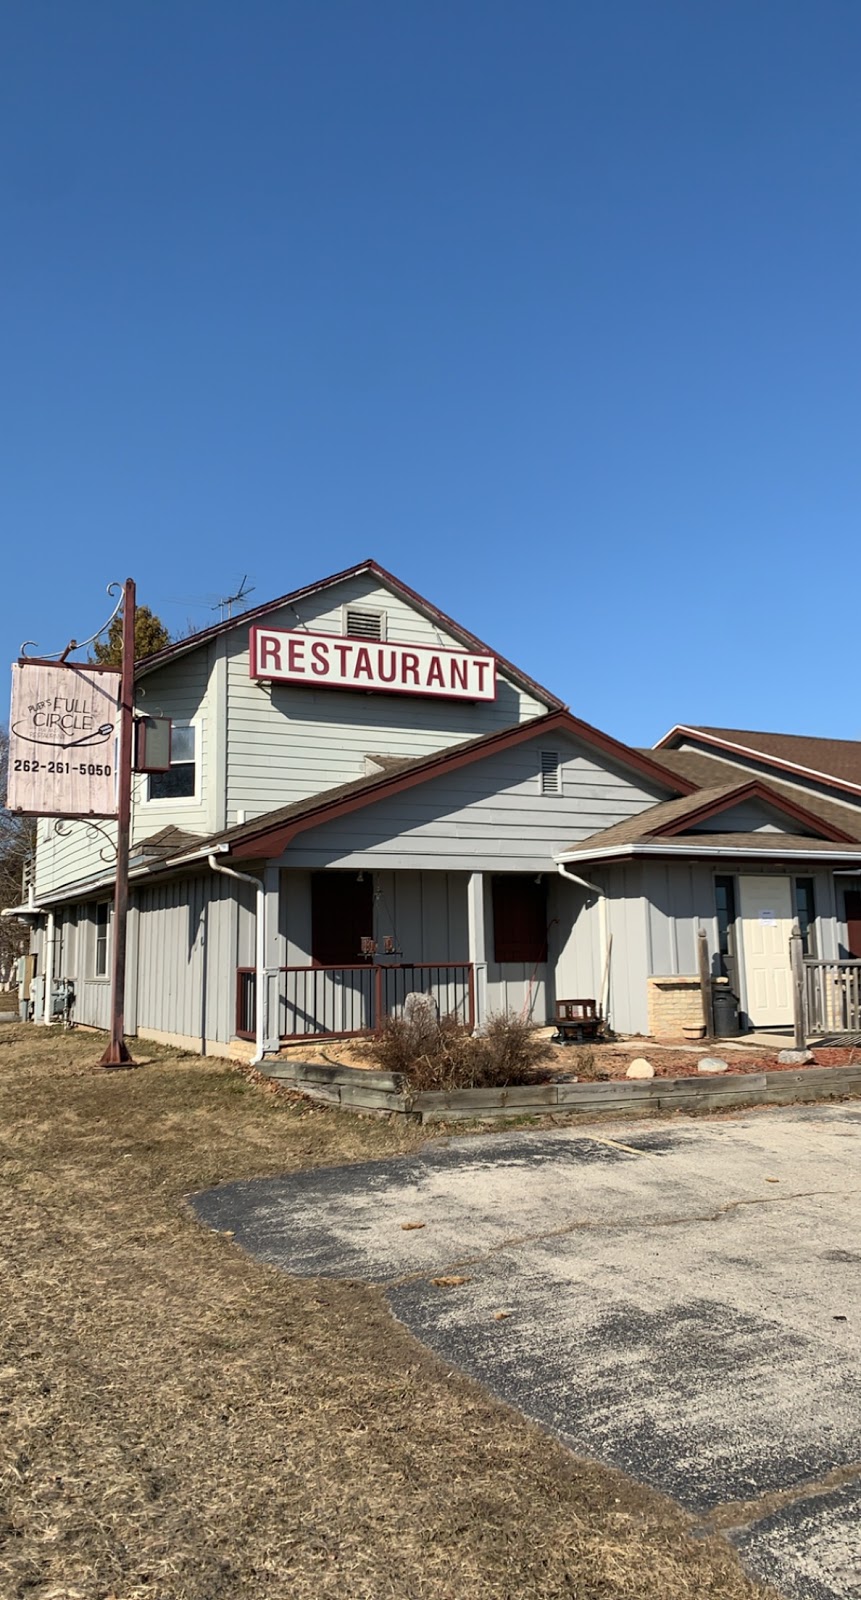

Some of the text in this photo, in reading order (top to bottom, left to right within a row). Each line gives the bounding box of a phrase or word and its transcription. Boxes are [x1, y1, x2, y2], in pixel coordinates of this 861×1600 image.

[260, 635, 490, 692] RESTAURANT
[53, 697, 91, 714] FULL
[33, 712, 93, 736] CIRCLE
[14, 760, 111, 776] 262-261-5050
